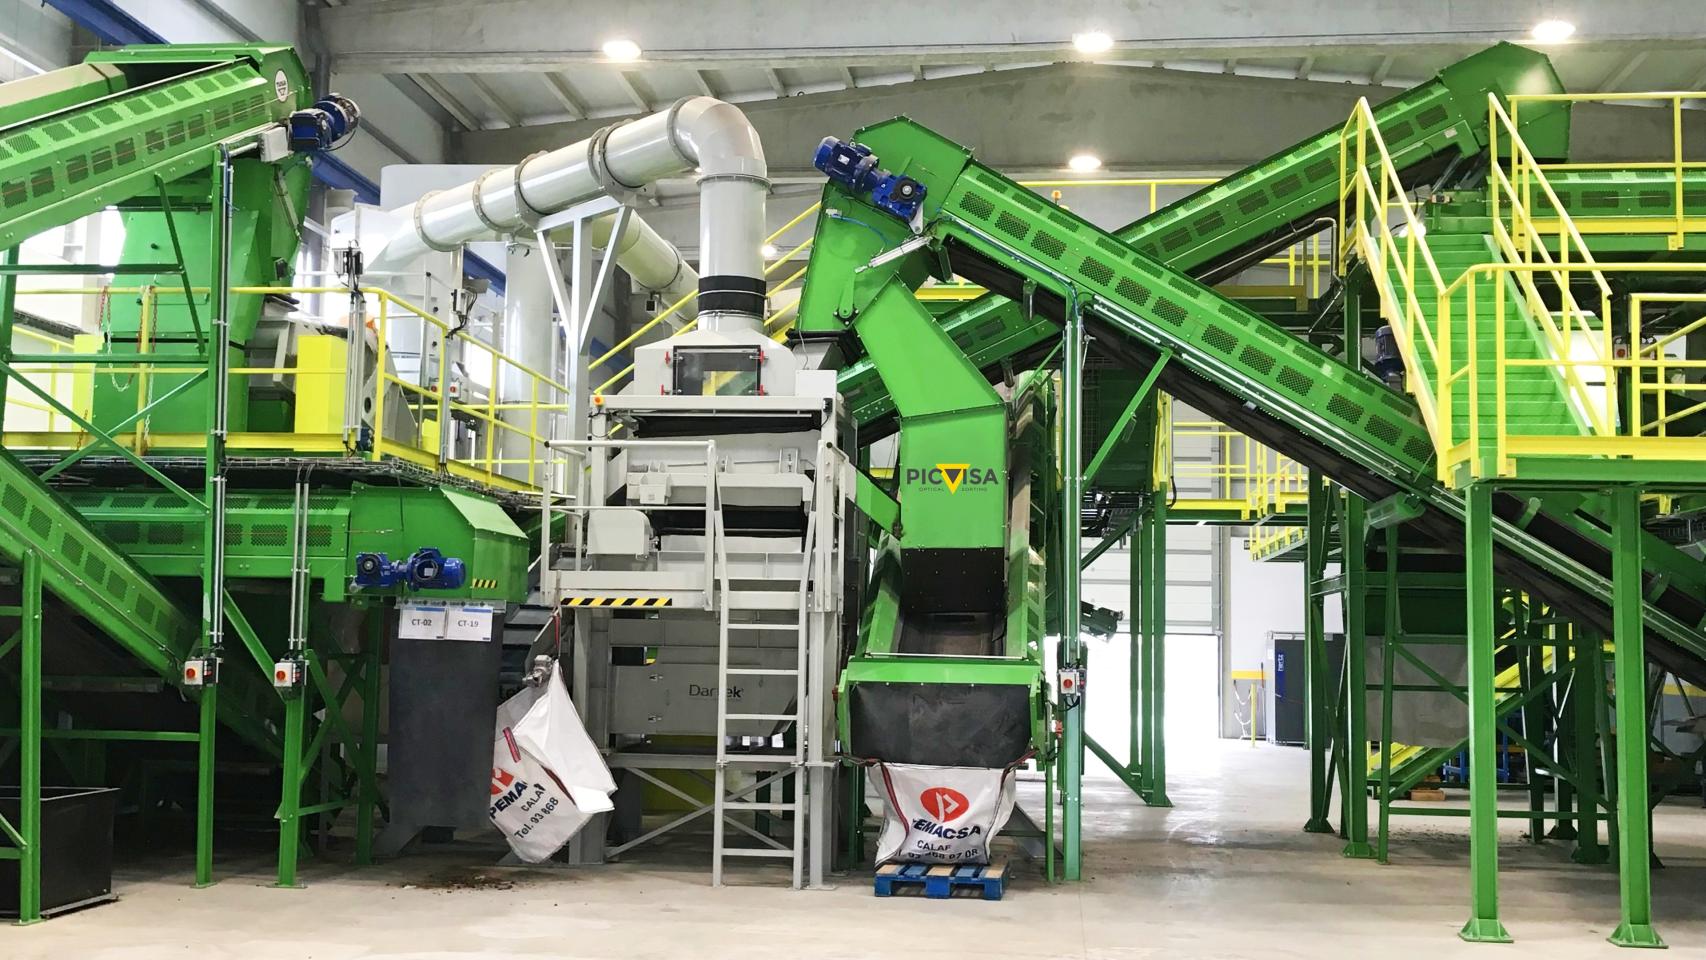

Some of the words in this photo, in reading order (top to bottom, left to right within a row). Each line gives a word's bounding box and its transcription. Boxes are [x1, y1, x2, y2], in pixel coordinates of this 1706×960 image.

[906, 464, 999, 493] PICVISA
[689, 684, 742, 698] Darek
[514, 823, 534, 839] Tel.
[530, 812, 544, 824] 93
[541, 797, 559, 815] 868
[964, 848, 978, 859] 08
